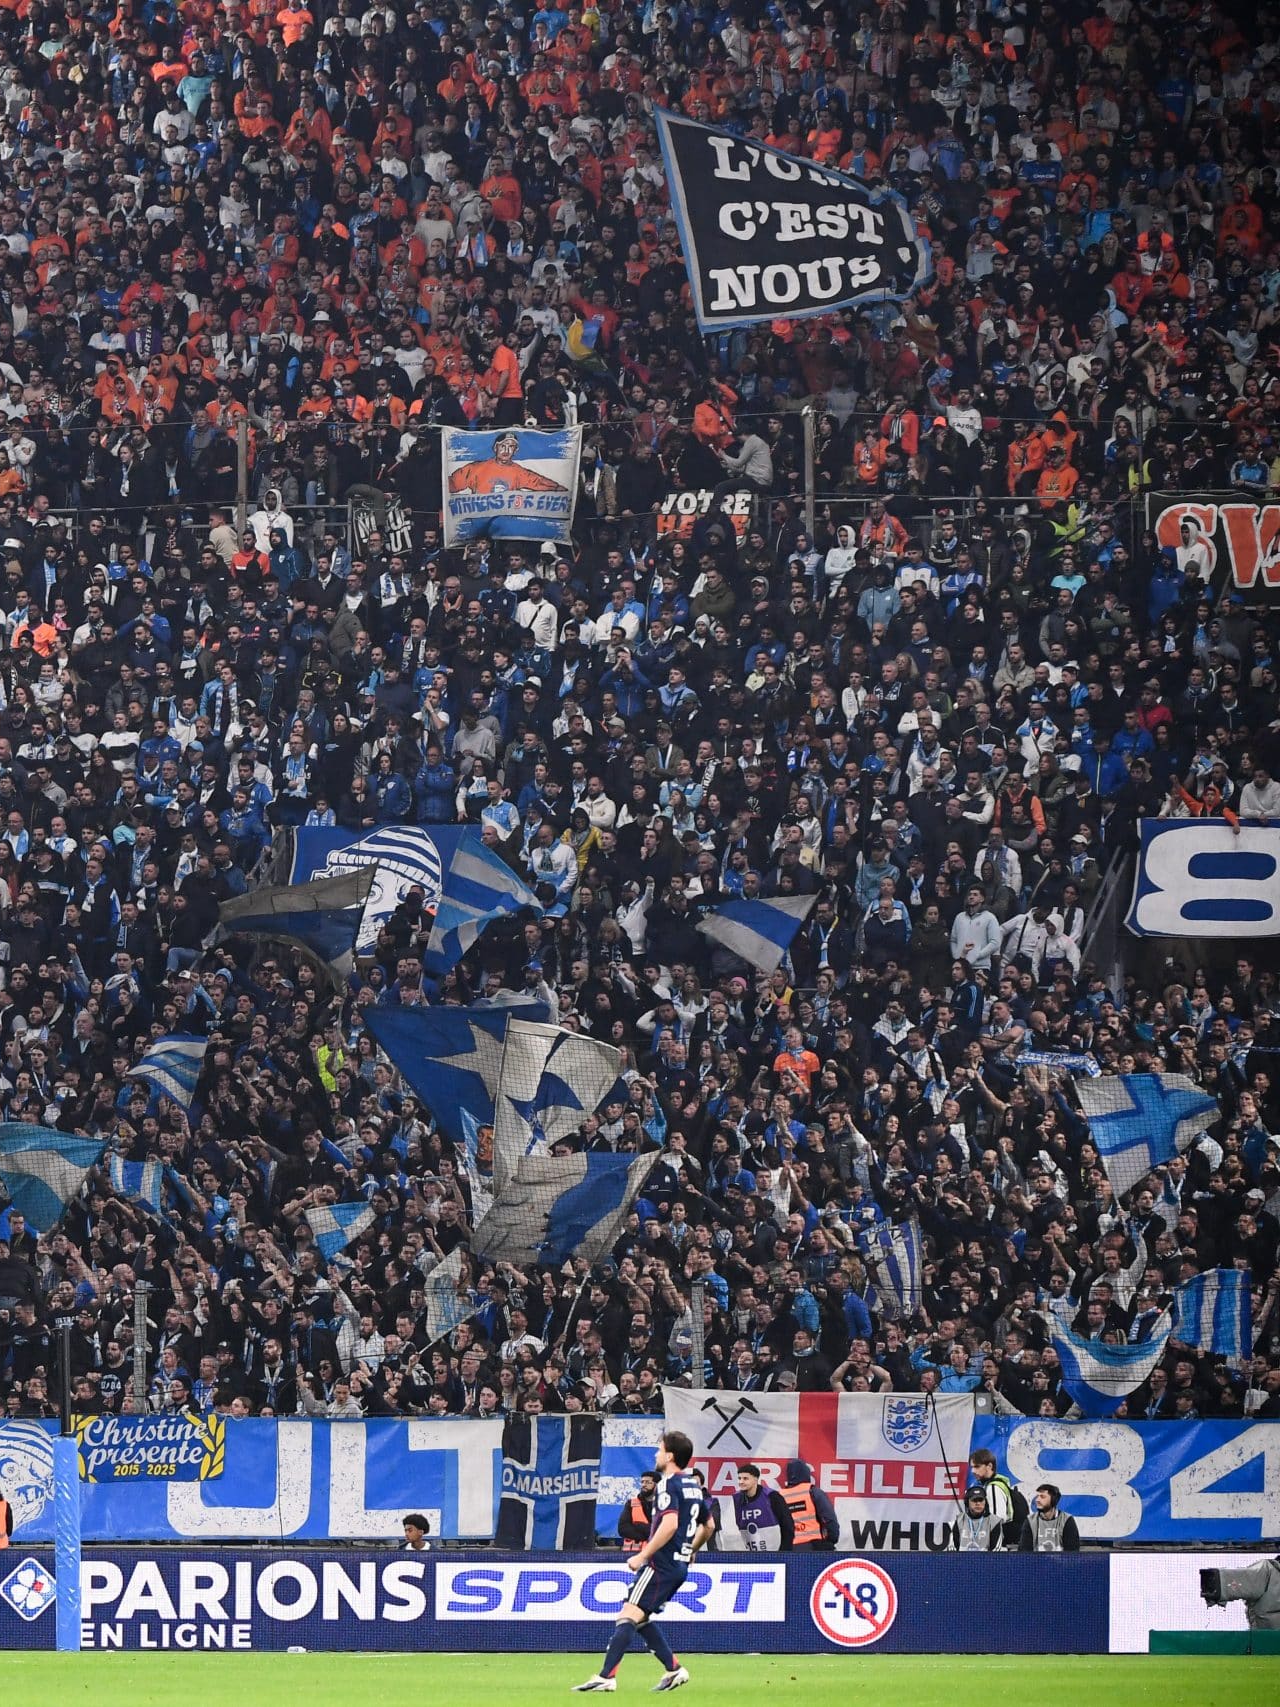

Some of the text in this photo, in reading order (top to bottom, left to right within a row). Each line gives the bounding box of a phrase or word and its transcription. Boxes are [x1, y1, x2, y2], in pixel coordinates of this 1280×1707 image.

[707, 136, 858, 191] L'O
[719, 201, 885, 245] C'EST
[709, 254, 882, 311] NOUS
[83, 1417, 209, 1447] Christine
[87, 1440, 204, 1474] présente
[113, 1465, 139, 1477] 2015
[146, 1464, 176, 1476] 2025
[686, 1503, 700, 1537] 3
[741, 1508, 762, 1521] LFP
[81, 1560, 776, 1622] PARIONS SPORT
[823, 1582, 879, 1620] -18
[80, 1623, 252, 1649] EN LIGNE
